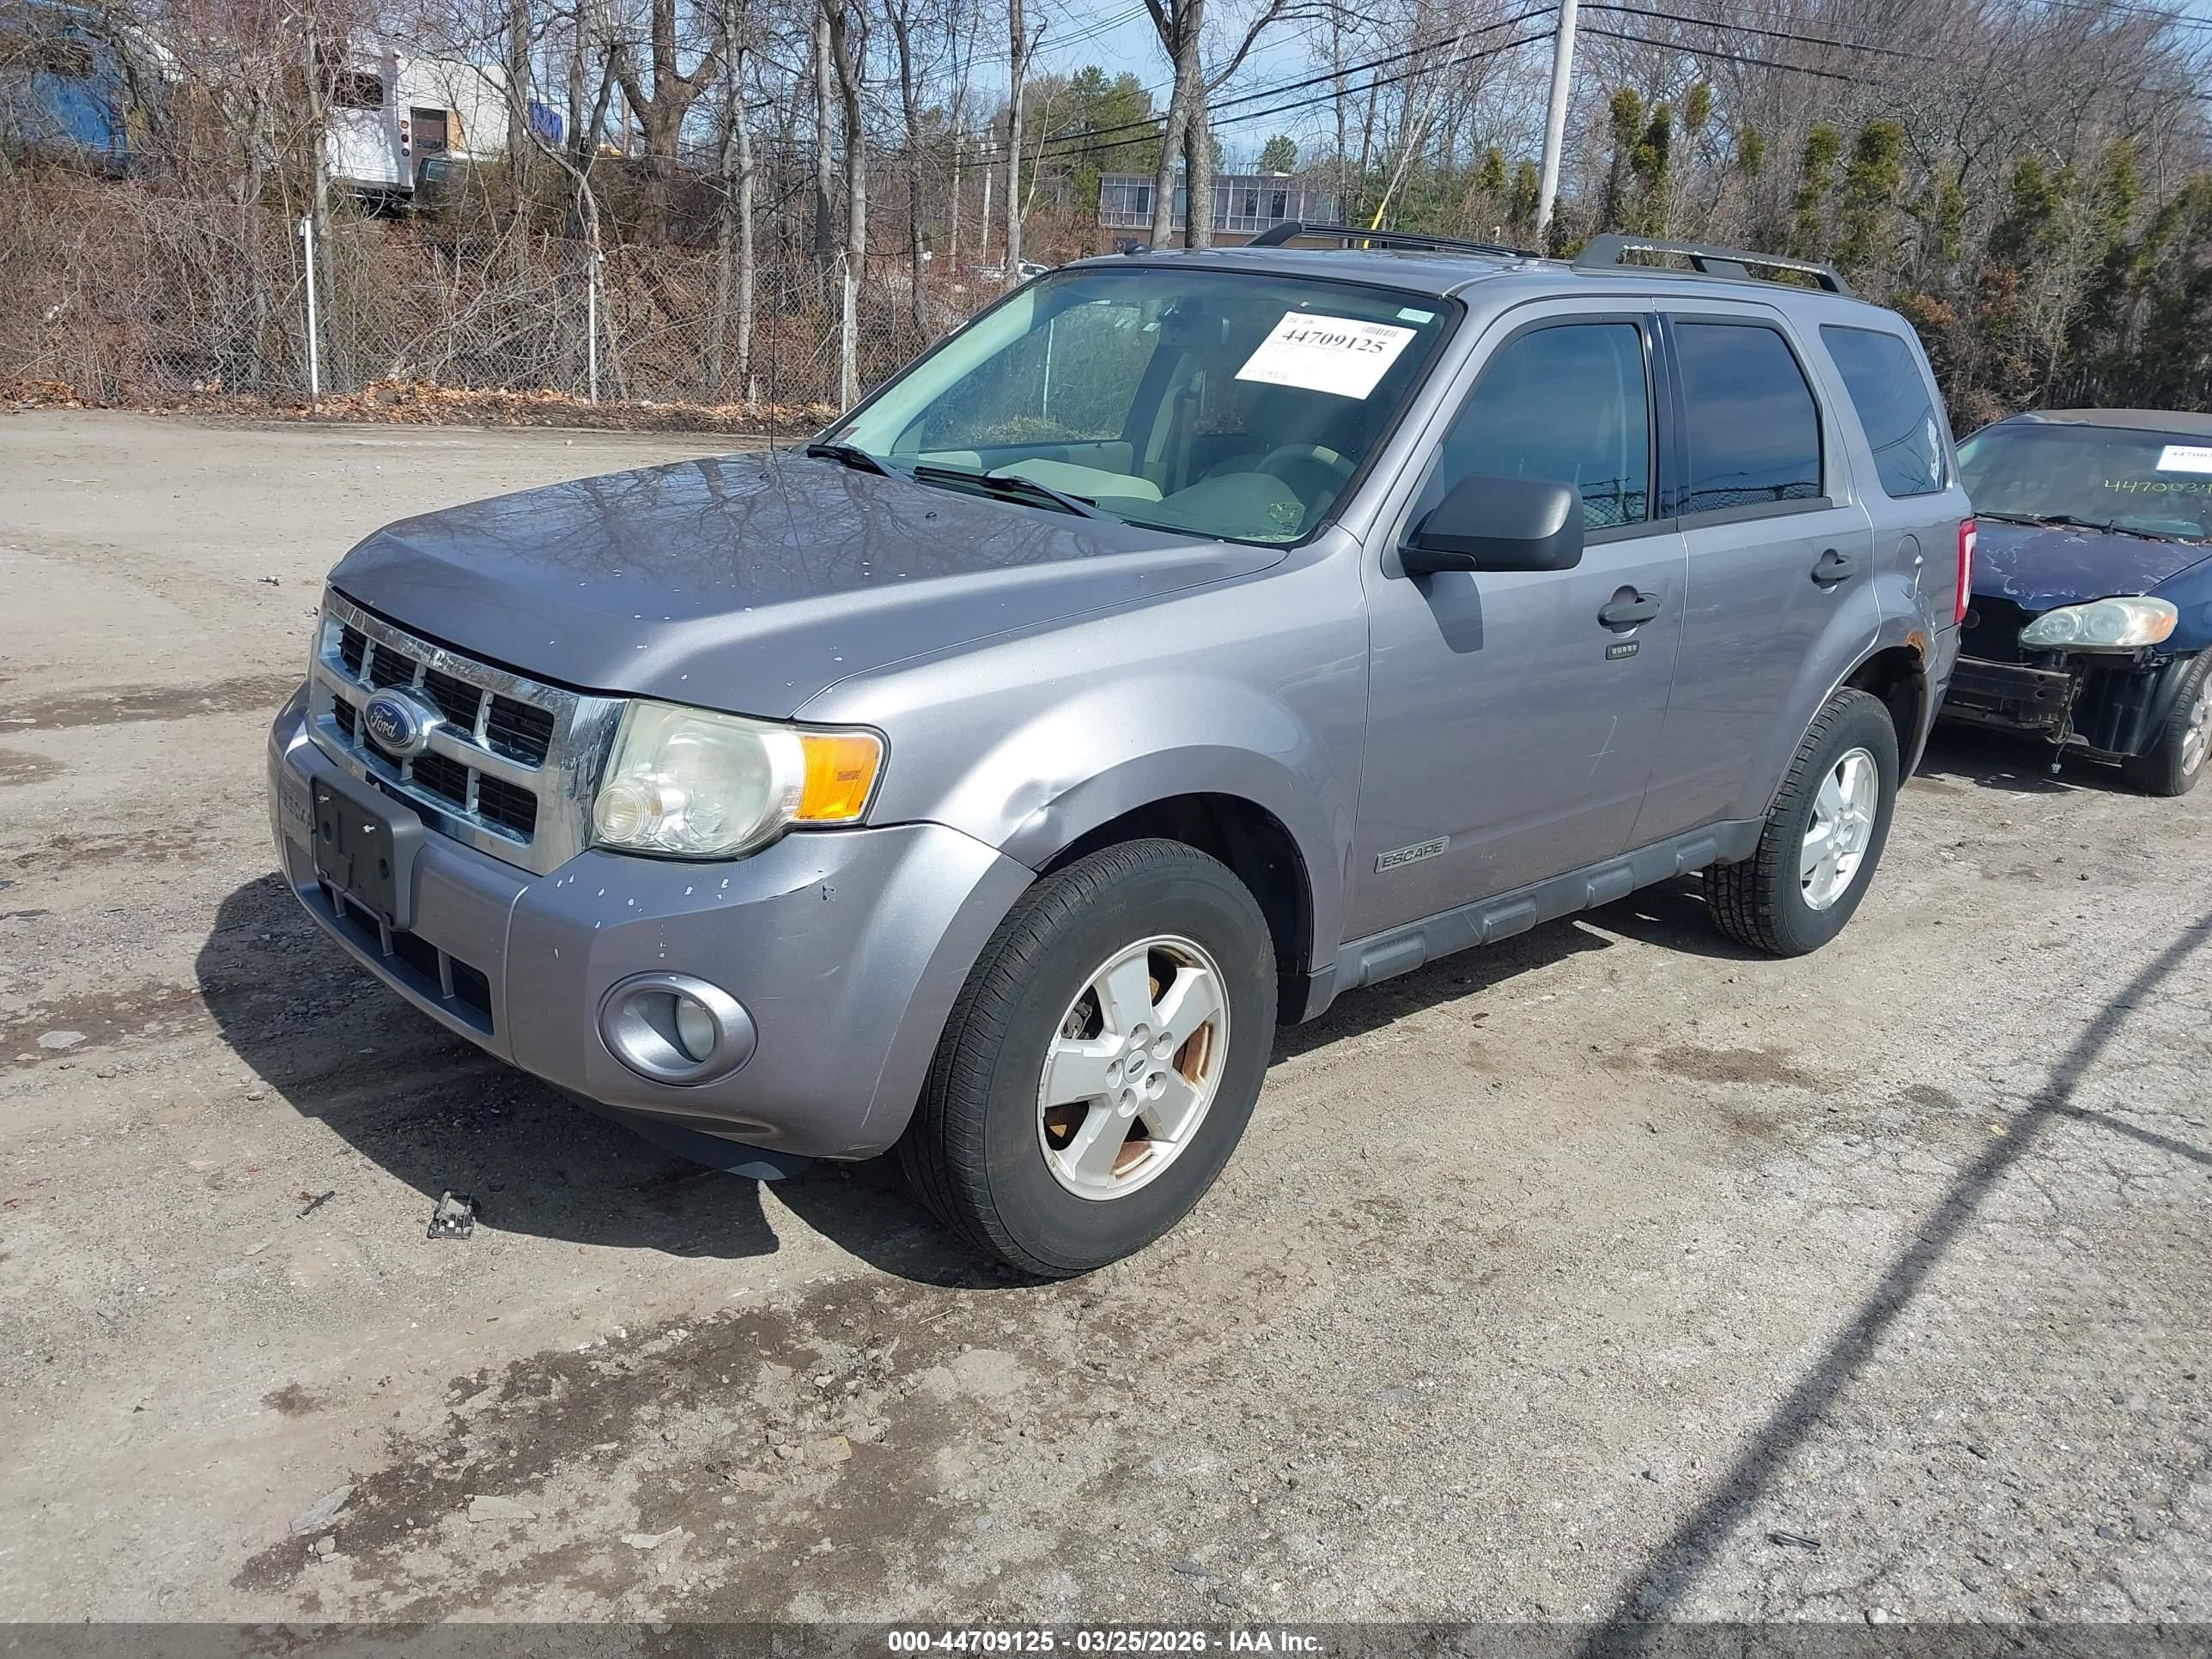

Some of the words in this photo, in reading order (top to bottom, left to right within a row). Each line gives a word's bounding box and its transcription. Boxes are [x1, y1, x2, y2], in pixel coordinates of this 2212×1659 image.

[1281, 328, 1389, 354] 44709125
[370, 705, 398, 738] Ford
[1381, 841, 1444, 868] ESCAPE
